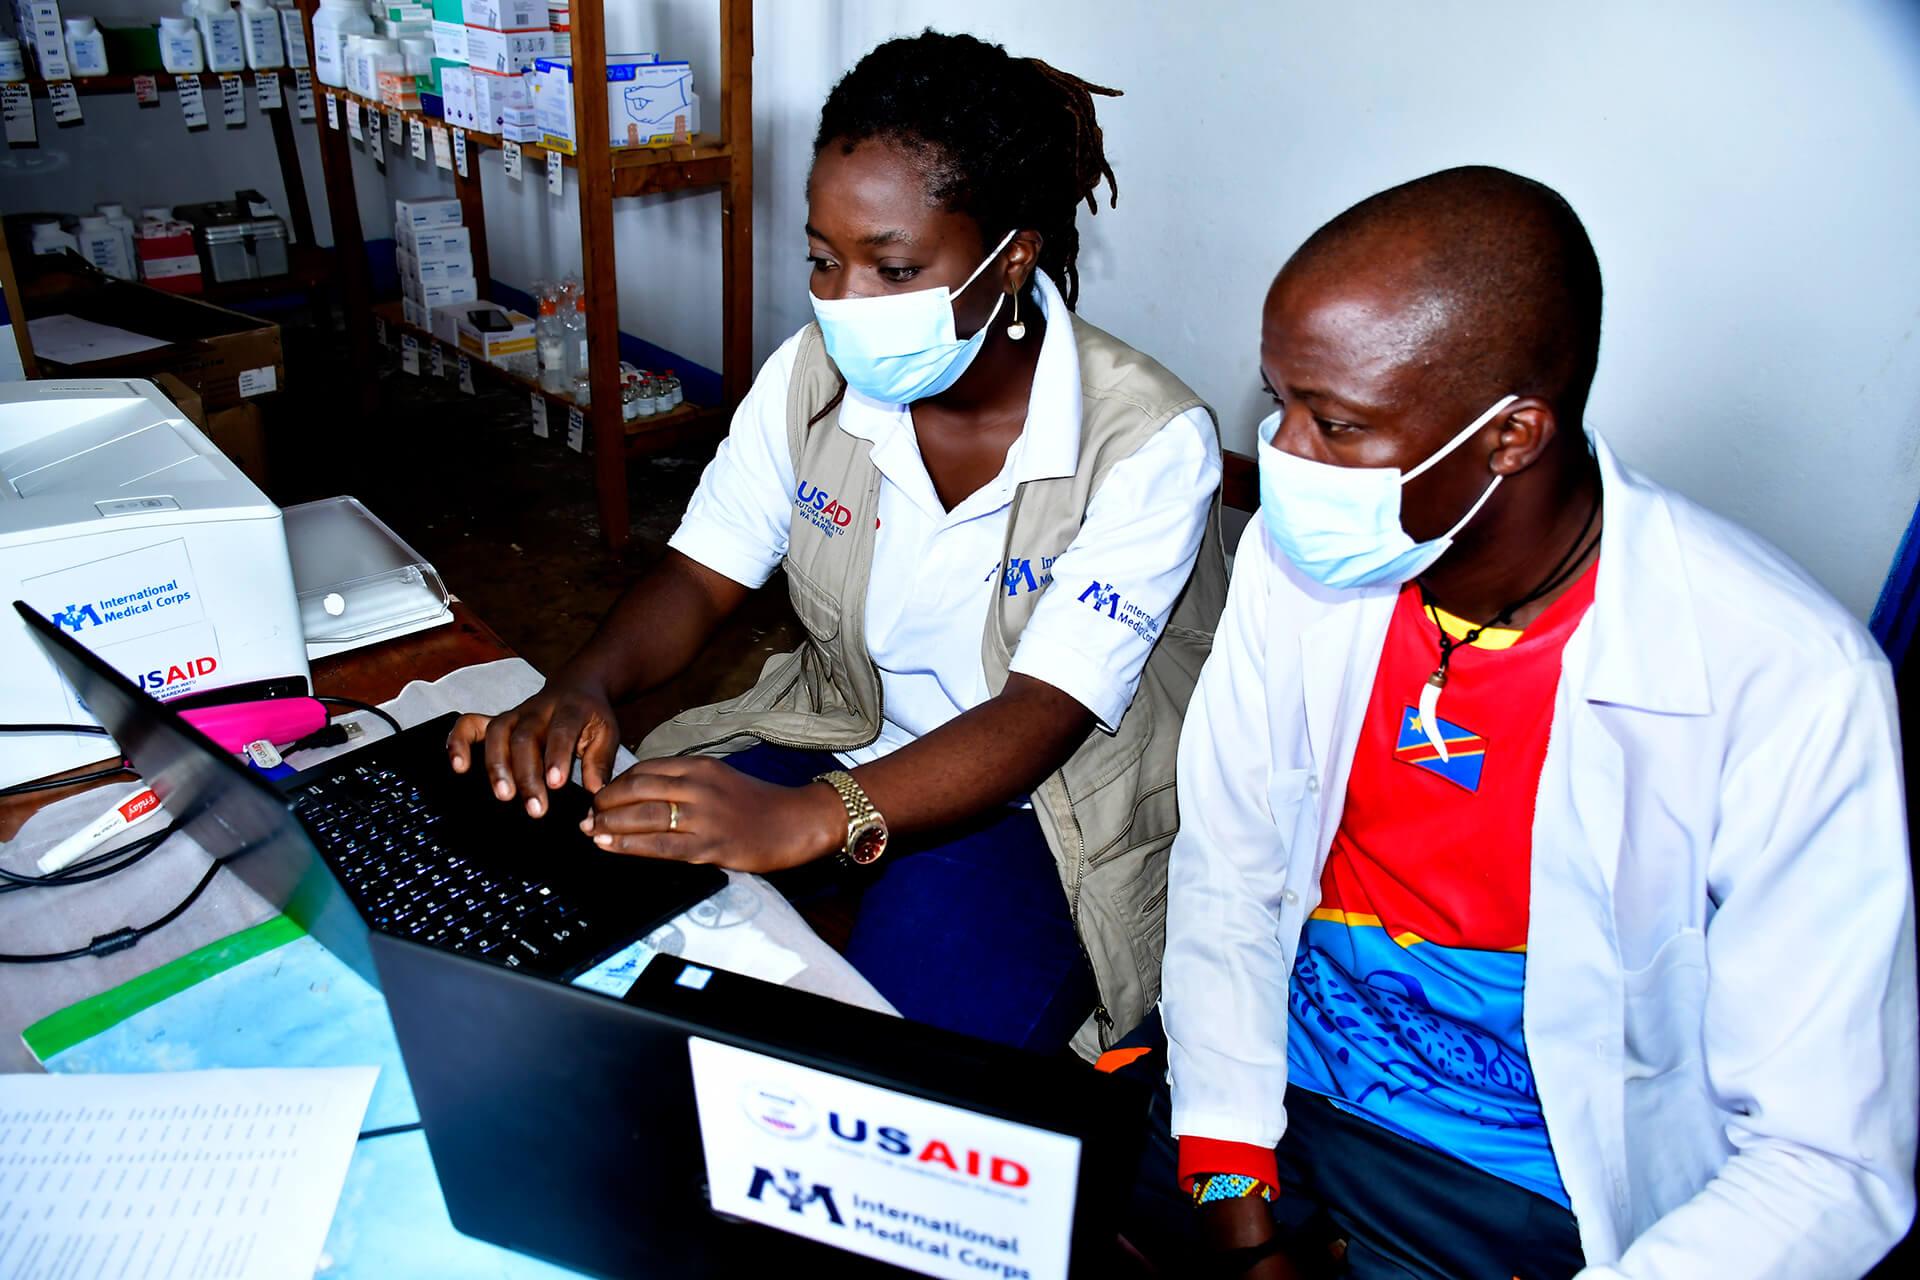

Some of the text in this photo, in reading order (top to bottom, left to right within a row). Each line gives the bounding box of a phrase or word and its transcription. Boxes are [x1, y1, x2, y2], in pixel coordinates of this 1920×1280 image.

[100, 579, 178, 610] International
[104, 590, 191, 624] Medical Corps
[128, 796, 156, 818] Friday
[829, 1111, 1030, 1188] USAID
[852, 1193, 1018, 1254] International
[853, 1217, 1030, 1280] Medical Corps
